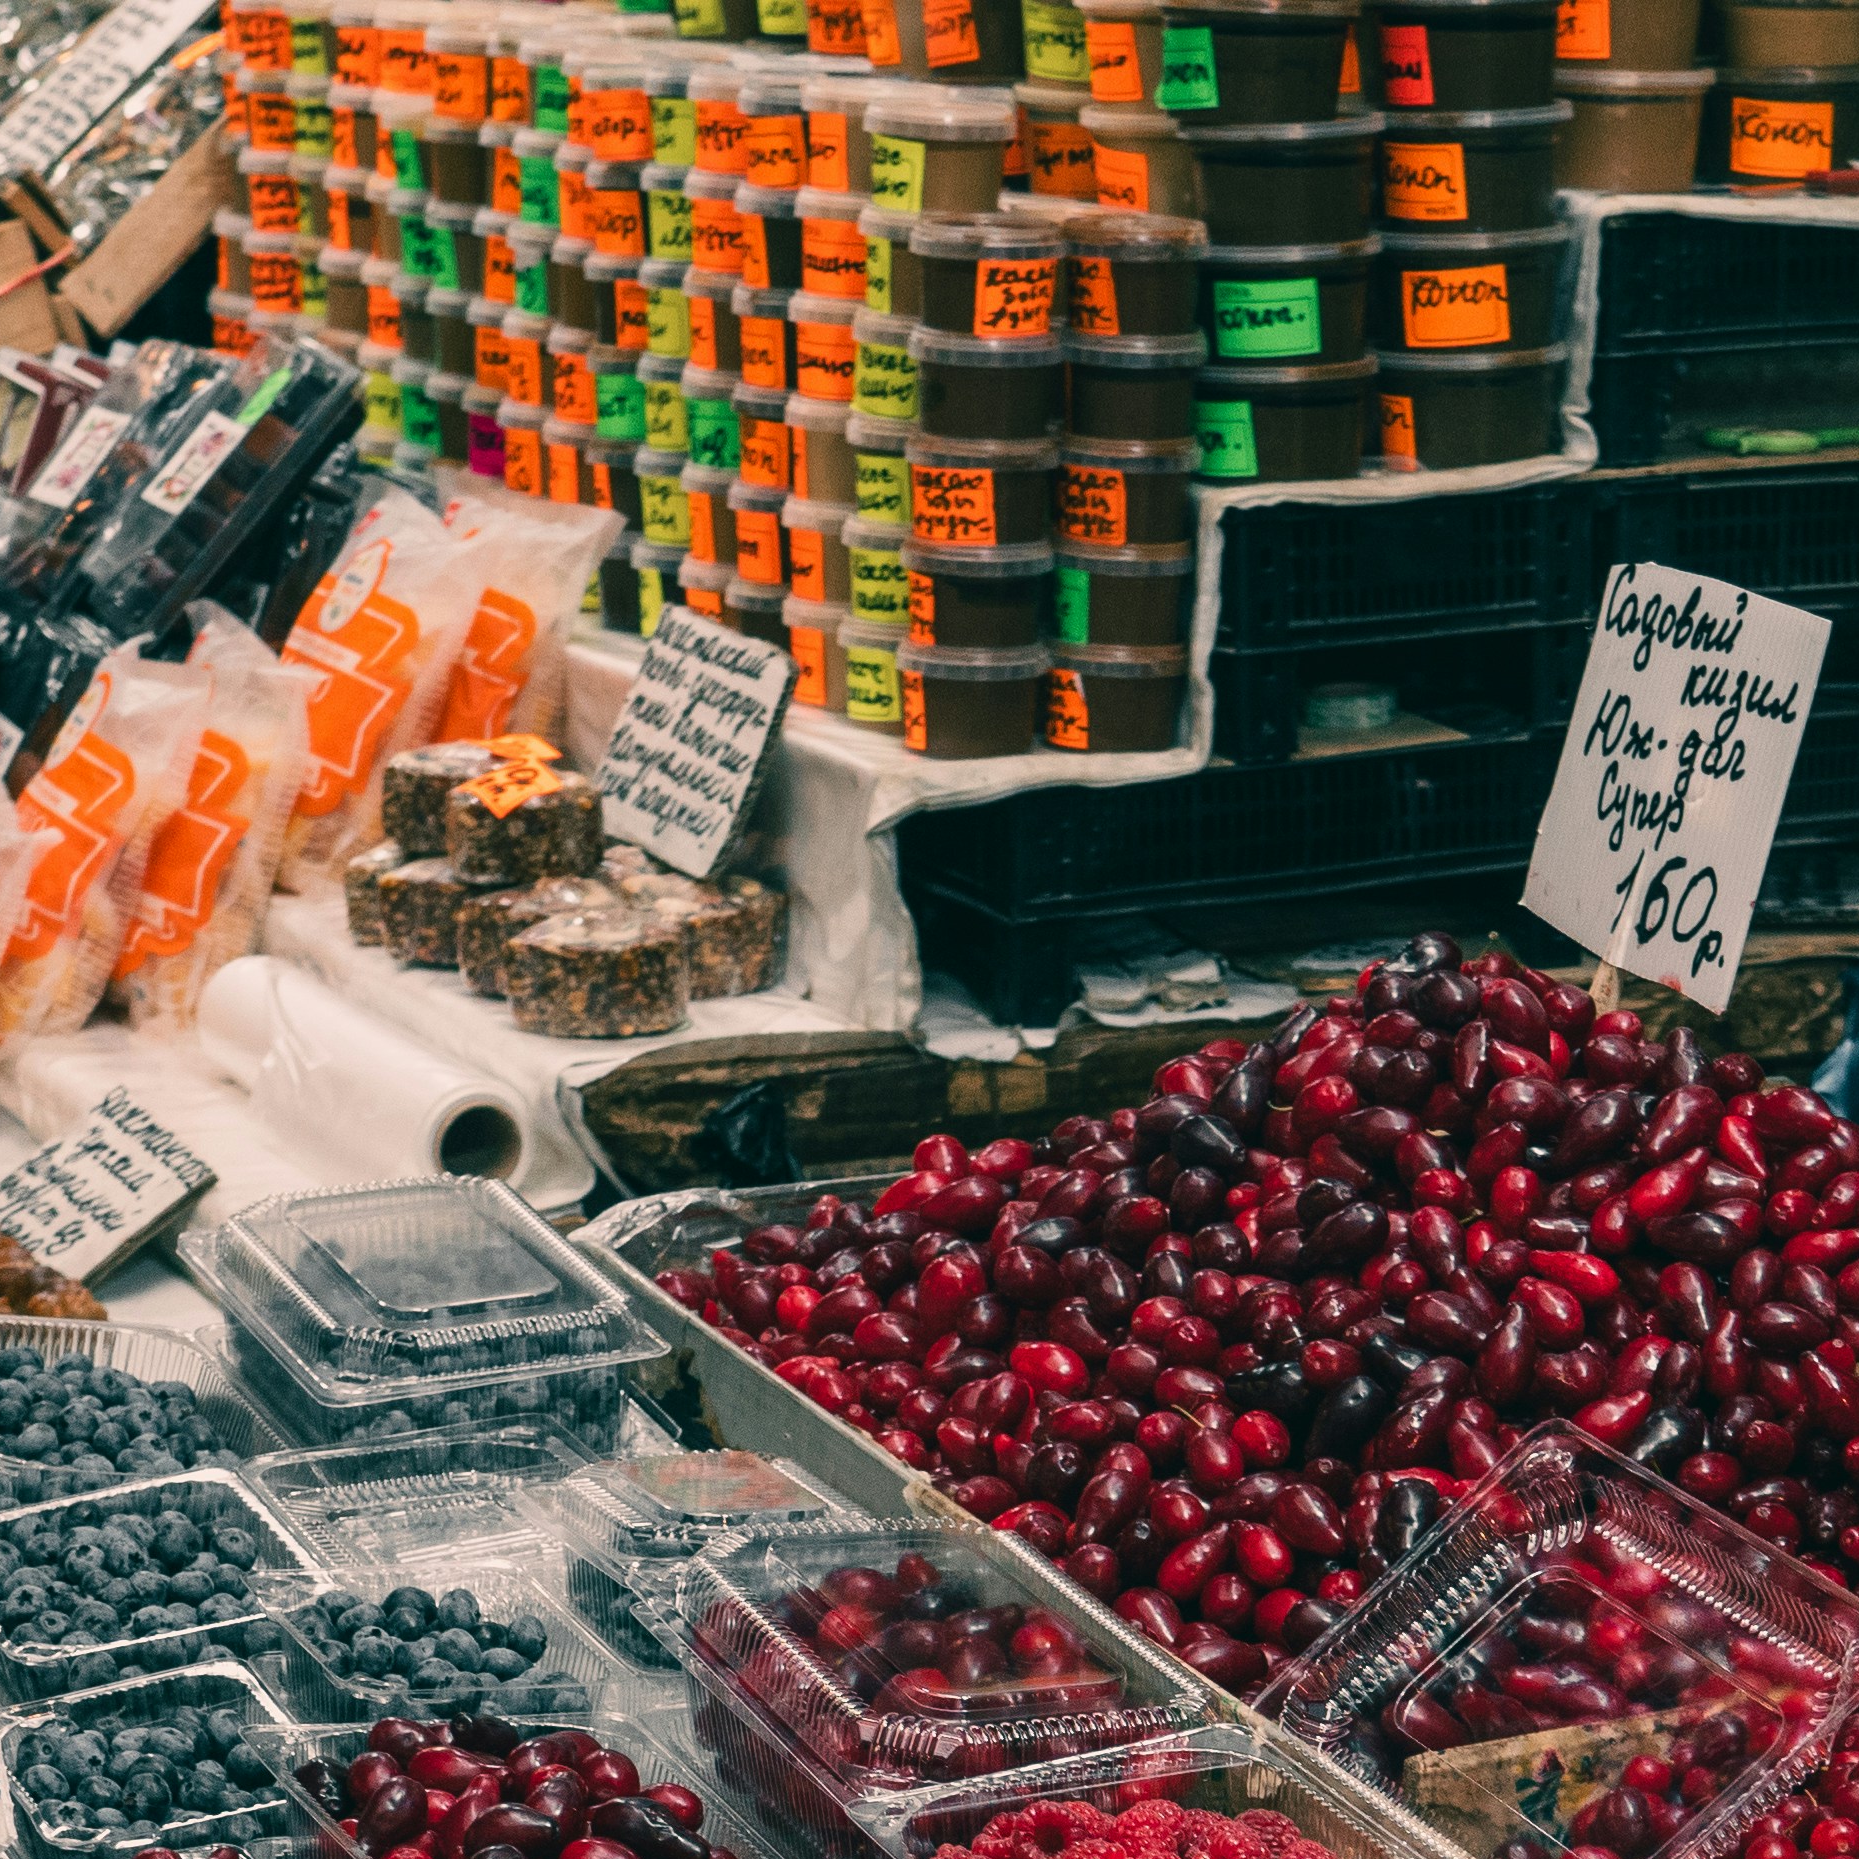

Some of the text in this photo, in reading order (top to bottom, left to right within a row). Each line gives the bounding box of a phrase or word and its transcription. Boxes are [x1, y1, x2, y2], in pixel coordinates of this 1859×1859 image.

[1604, 563, 1748, 672] Садовый
[1680, 663, 1799, 738] кизил
[1596, 760, 1686, 852] Супер
